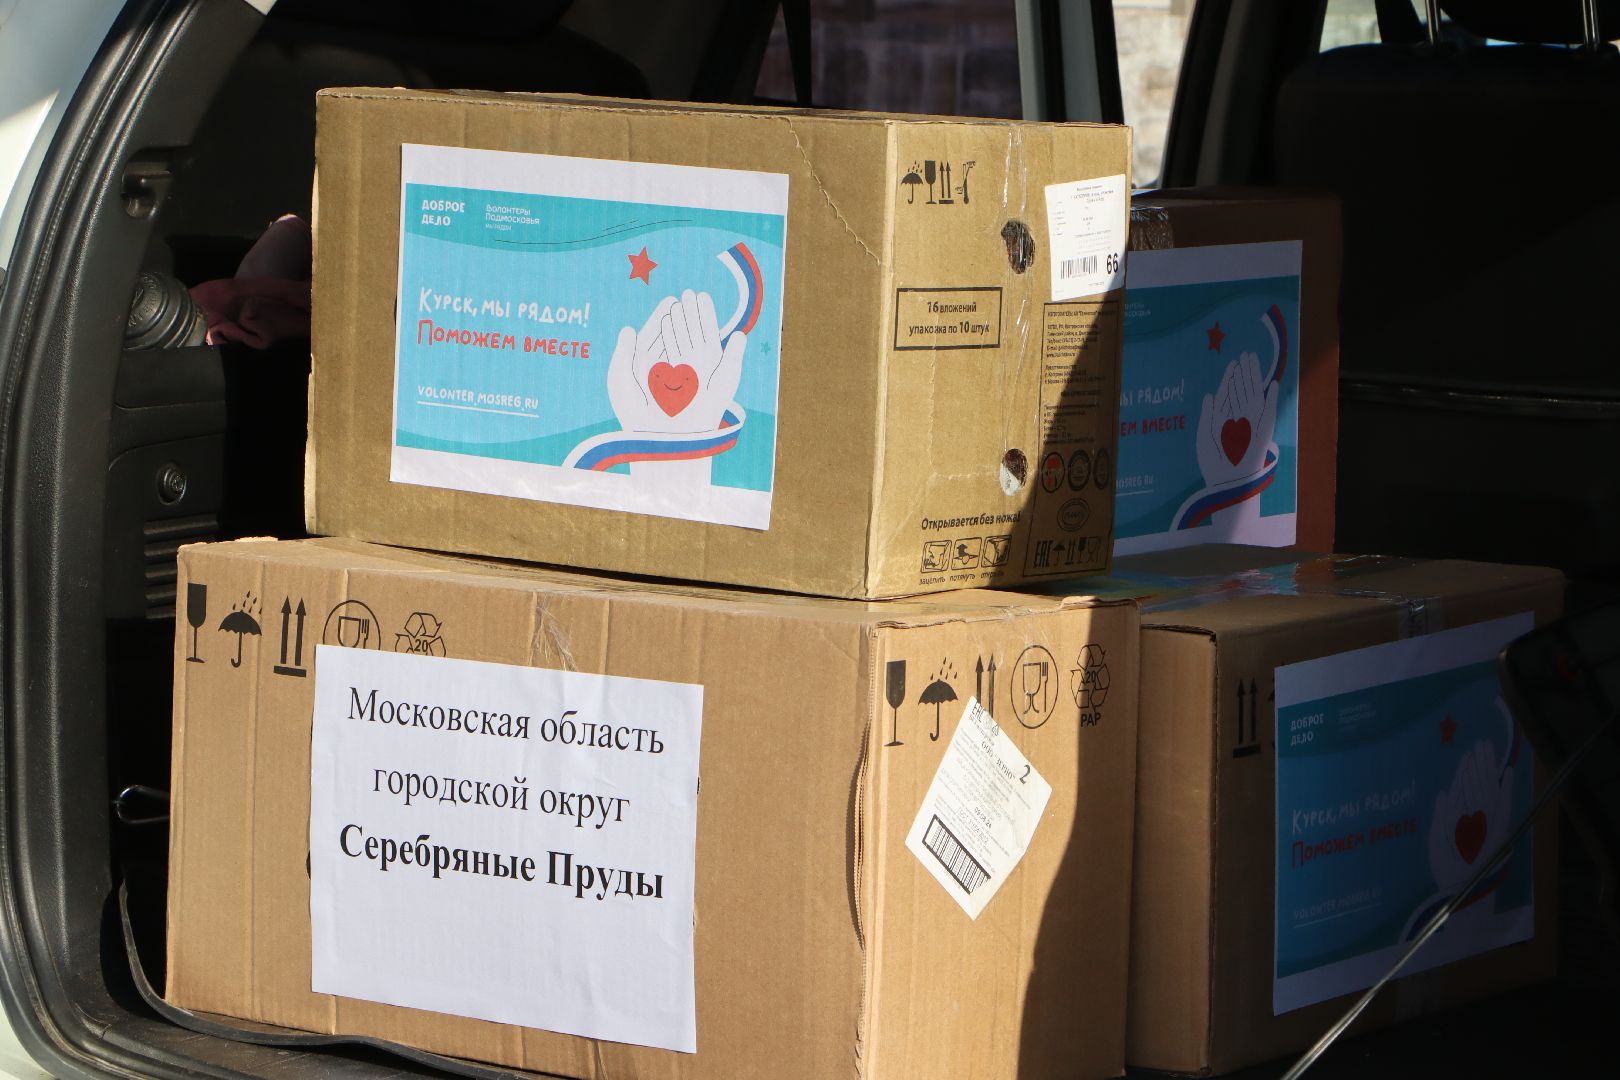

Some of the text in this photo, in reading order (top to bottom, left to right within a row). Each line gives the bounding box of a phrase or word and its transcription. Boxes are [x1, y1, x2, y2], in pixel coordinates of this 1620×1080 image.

[422, 199, 465, 213] ДОБРОЕ
[422, 214, 451, 226] ДЕЛО
[1106, 252, 1119, 275] 66
[927, 301, 976, 313] 16 вложений
[909, 321, 990, 337] упаковка по 10 штук
[417, 385, 539, 411] VOLONTER.MOSREG.RU
[921, 510, 1021, 531] Открывается без ножа!
[414, 638, 429, 652] 20
[1085, 670, 1097, 684] 20
[347, 687, 665, 755] Московская область
[1081, 713, 1102, 727] PAP
[1290, 713, 1324, 731] ДОБРОЕ
[1291, 731, 1314, 746] ДЕЛО
[1019, 764, 1031, 785] 2
[373, 769, 630, 830] городской округ
[339, 824, 665, 901] Серебряные Пруды
